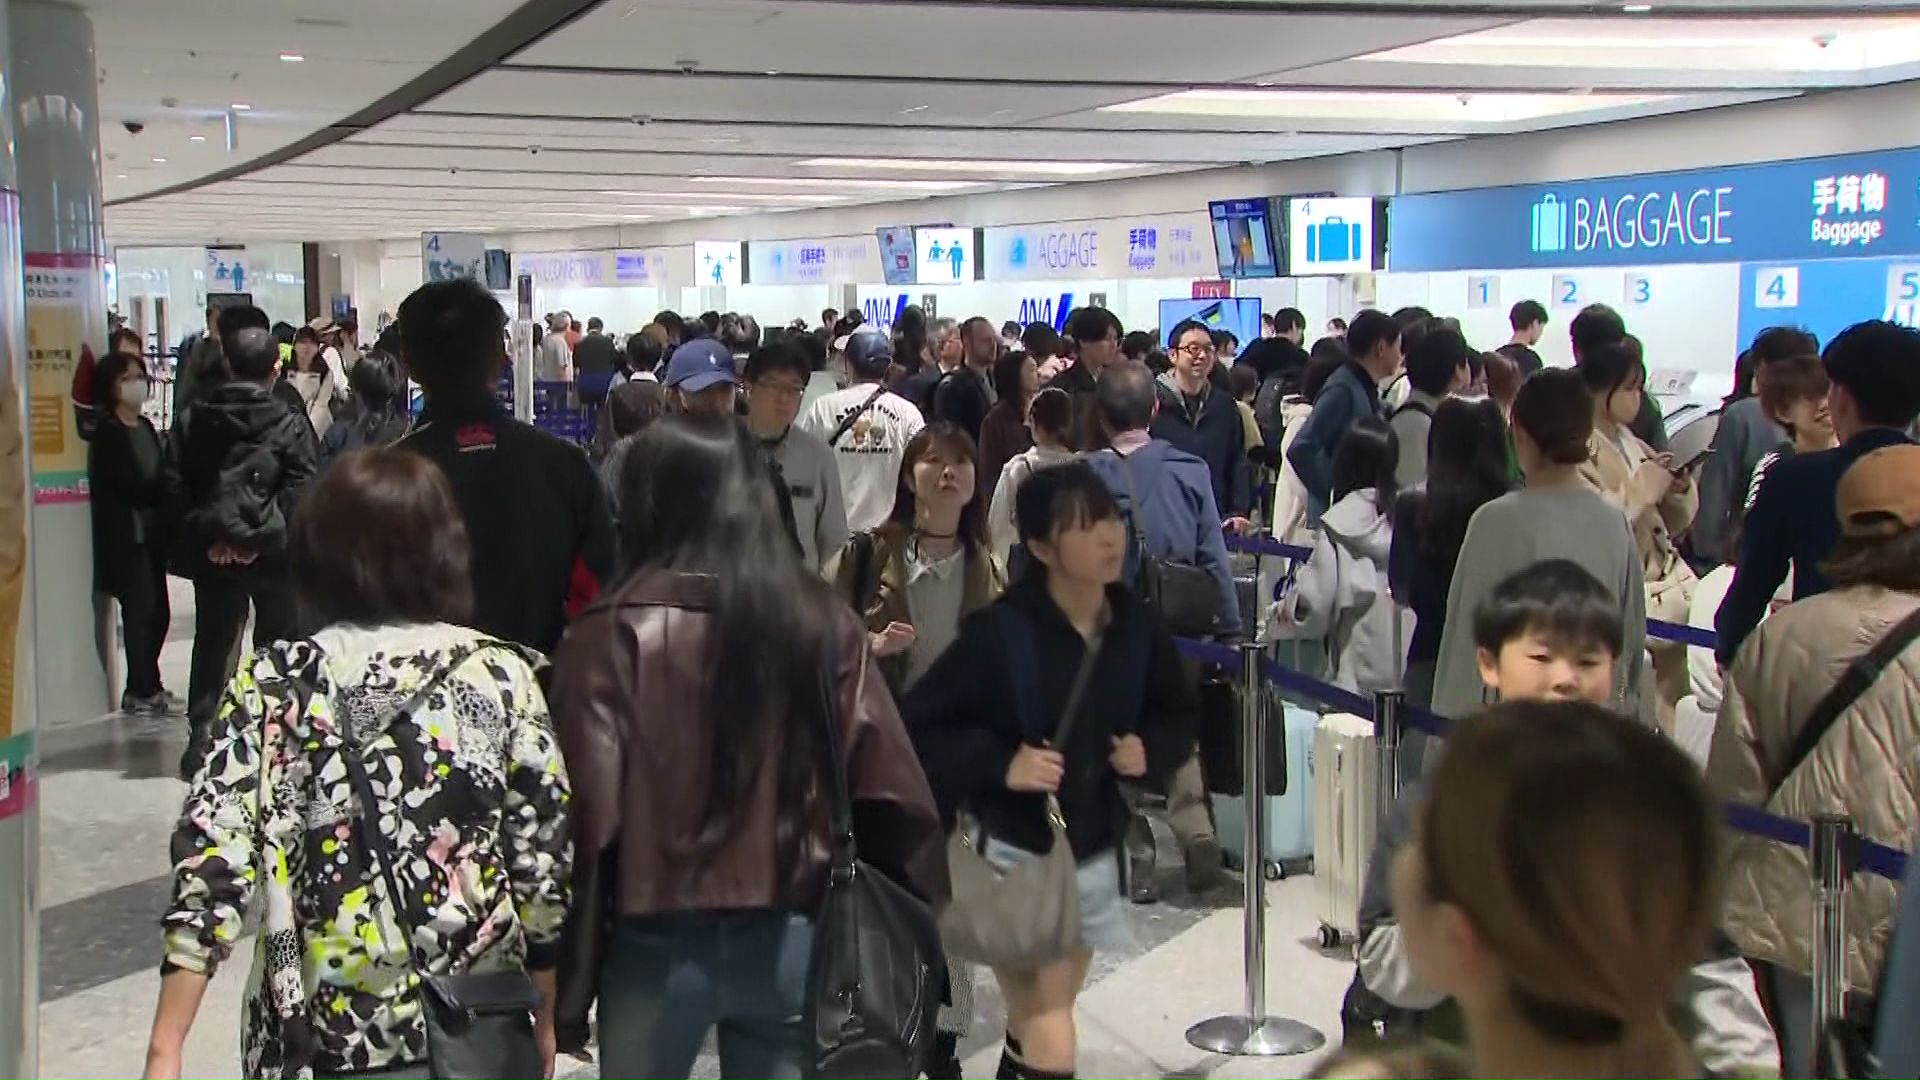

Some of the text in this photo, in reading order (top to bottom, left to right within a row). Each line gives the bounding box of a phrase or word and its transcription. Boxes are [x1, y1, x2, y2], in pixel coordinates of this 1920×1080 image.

[1301, 201, 1312, 215] 4
[1812, 173, 1886, 216] 手荷物
[1574, 187, 1733, 251] BAGGAGE
[1811, 218, 1882, 246] Baggage
[427, 235, 440, 252] 4
[1031, 231, 1098, 268] AGGAGE
[1479, 282, 1488, 304] 1
[1562, 281, 1577, 303] 2
[1634, 278, 1650, 303] 3
[1766, 275, 1786, 301] 4
[1900, 272, 1919, 299] 5
[863, 296, 892, 328] ANA
[1018, 296, 1052, 327] ANA
